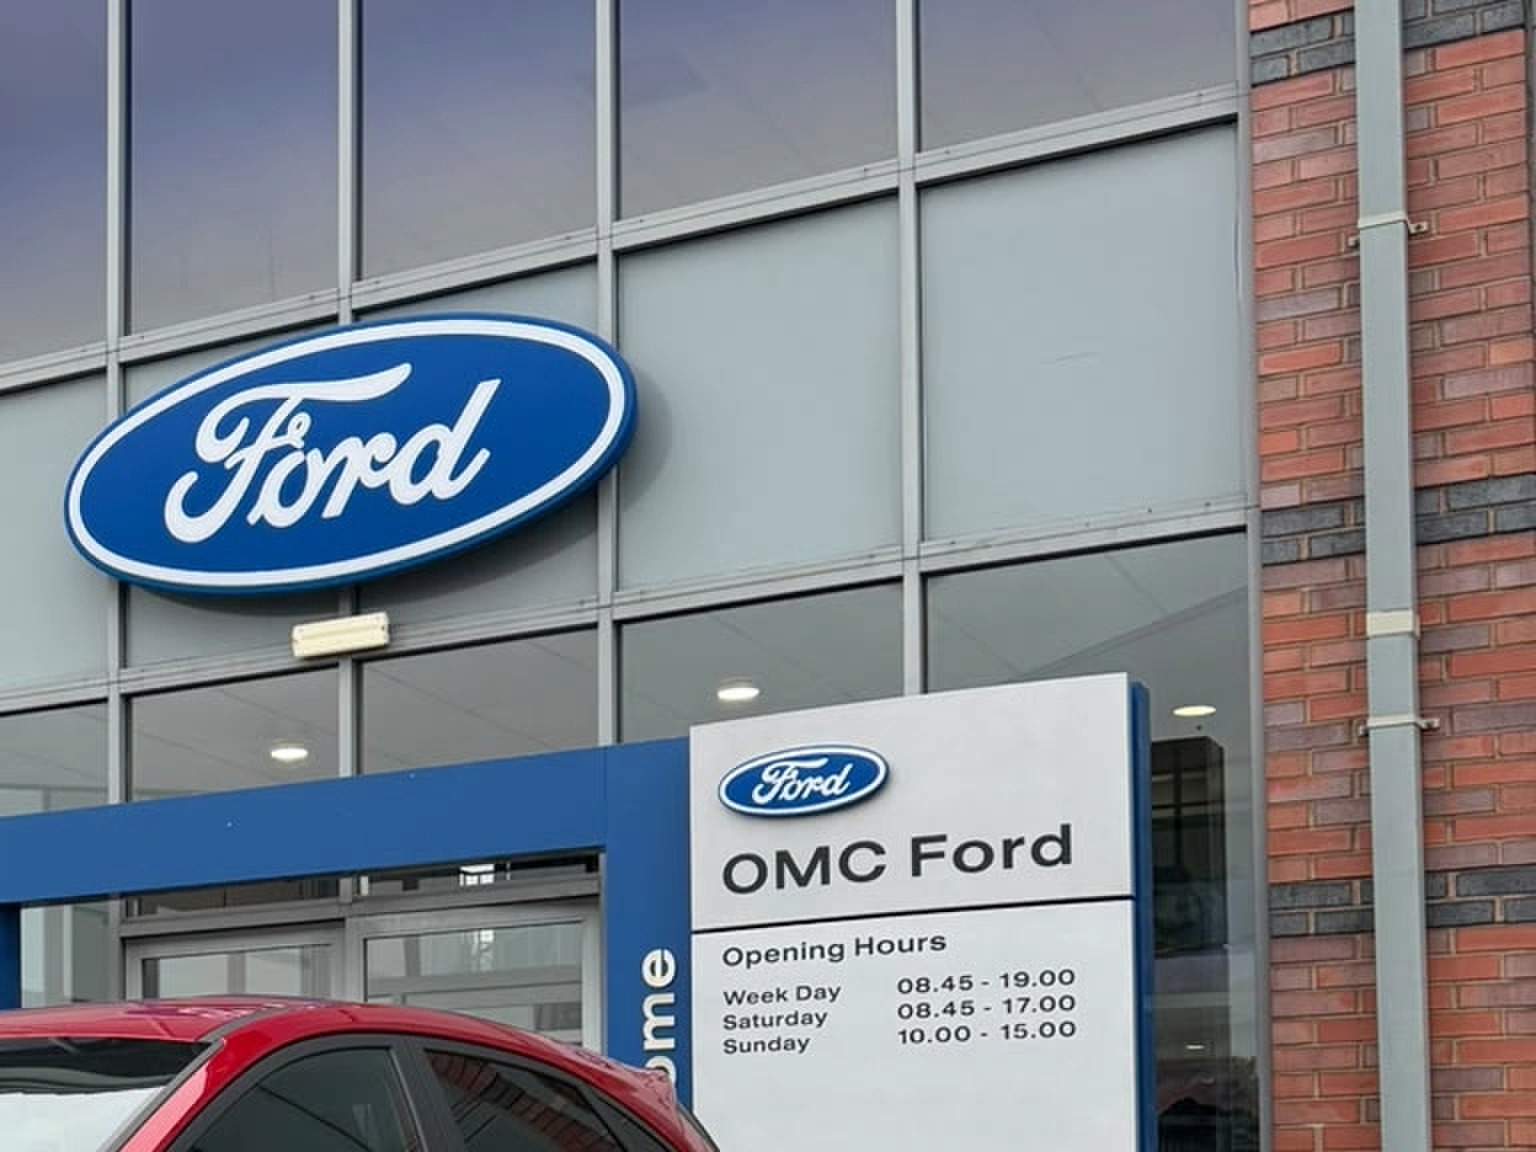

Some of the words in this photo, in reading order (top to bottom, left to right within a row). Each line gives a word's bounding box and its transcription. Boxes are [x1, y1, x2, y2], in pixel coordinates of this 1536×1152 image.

[164, 363, 501, 543] Ford
[751, 757, 853, 805] Ford
[722, 840, 886, 895] OMC
[911, 823, 1073, 878] Ford
[722, 941, 845, 970] Opening
[854, 935, 947, 957] Hours
[722, 987, 789, 1006] Week
[795, 985, 842, 1004] Day
[897, 974, 974, 995] 08.45
[999, 968, 1076, 989] 19.00
[722, 1010, 828, 1031] Saturday
[897, 999, 975, 1020] 08.45
[1002, 994, 1076, 1015] 17.00
[723, 1035, 811, 1055] Sunday
[897, 1025, 972, 1045] 10.00
[1000, 1020, 1077, 1041] 15.00
